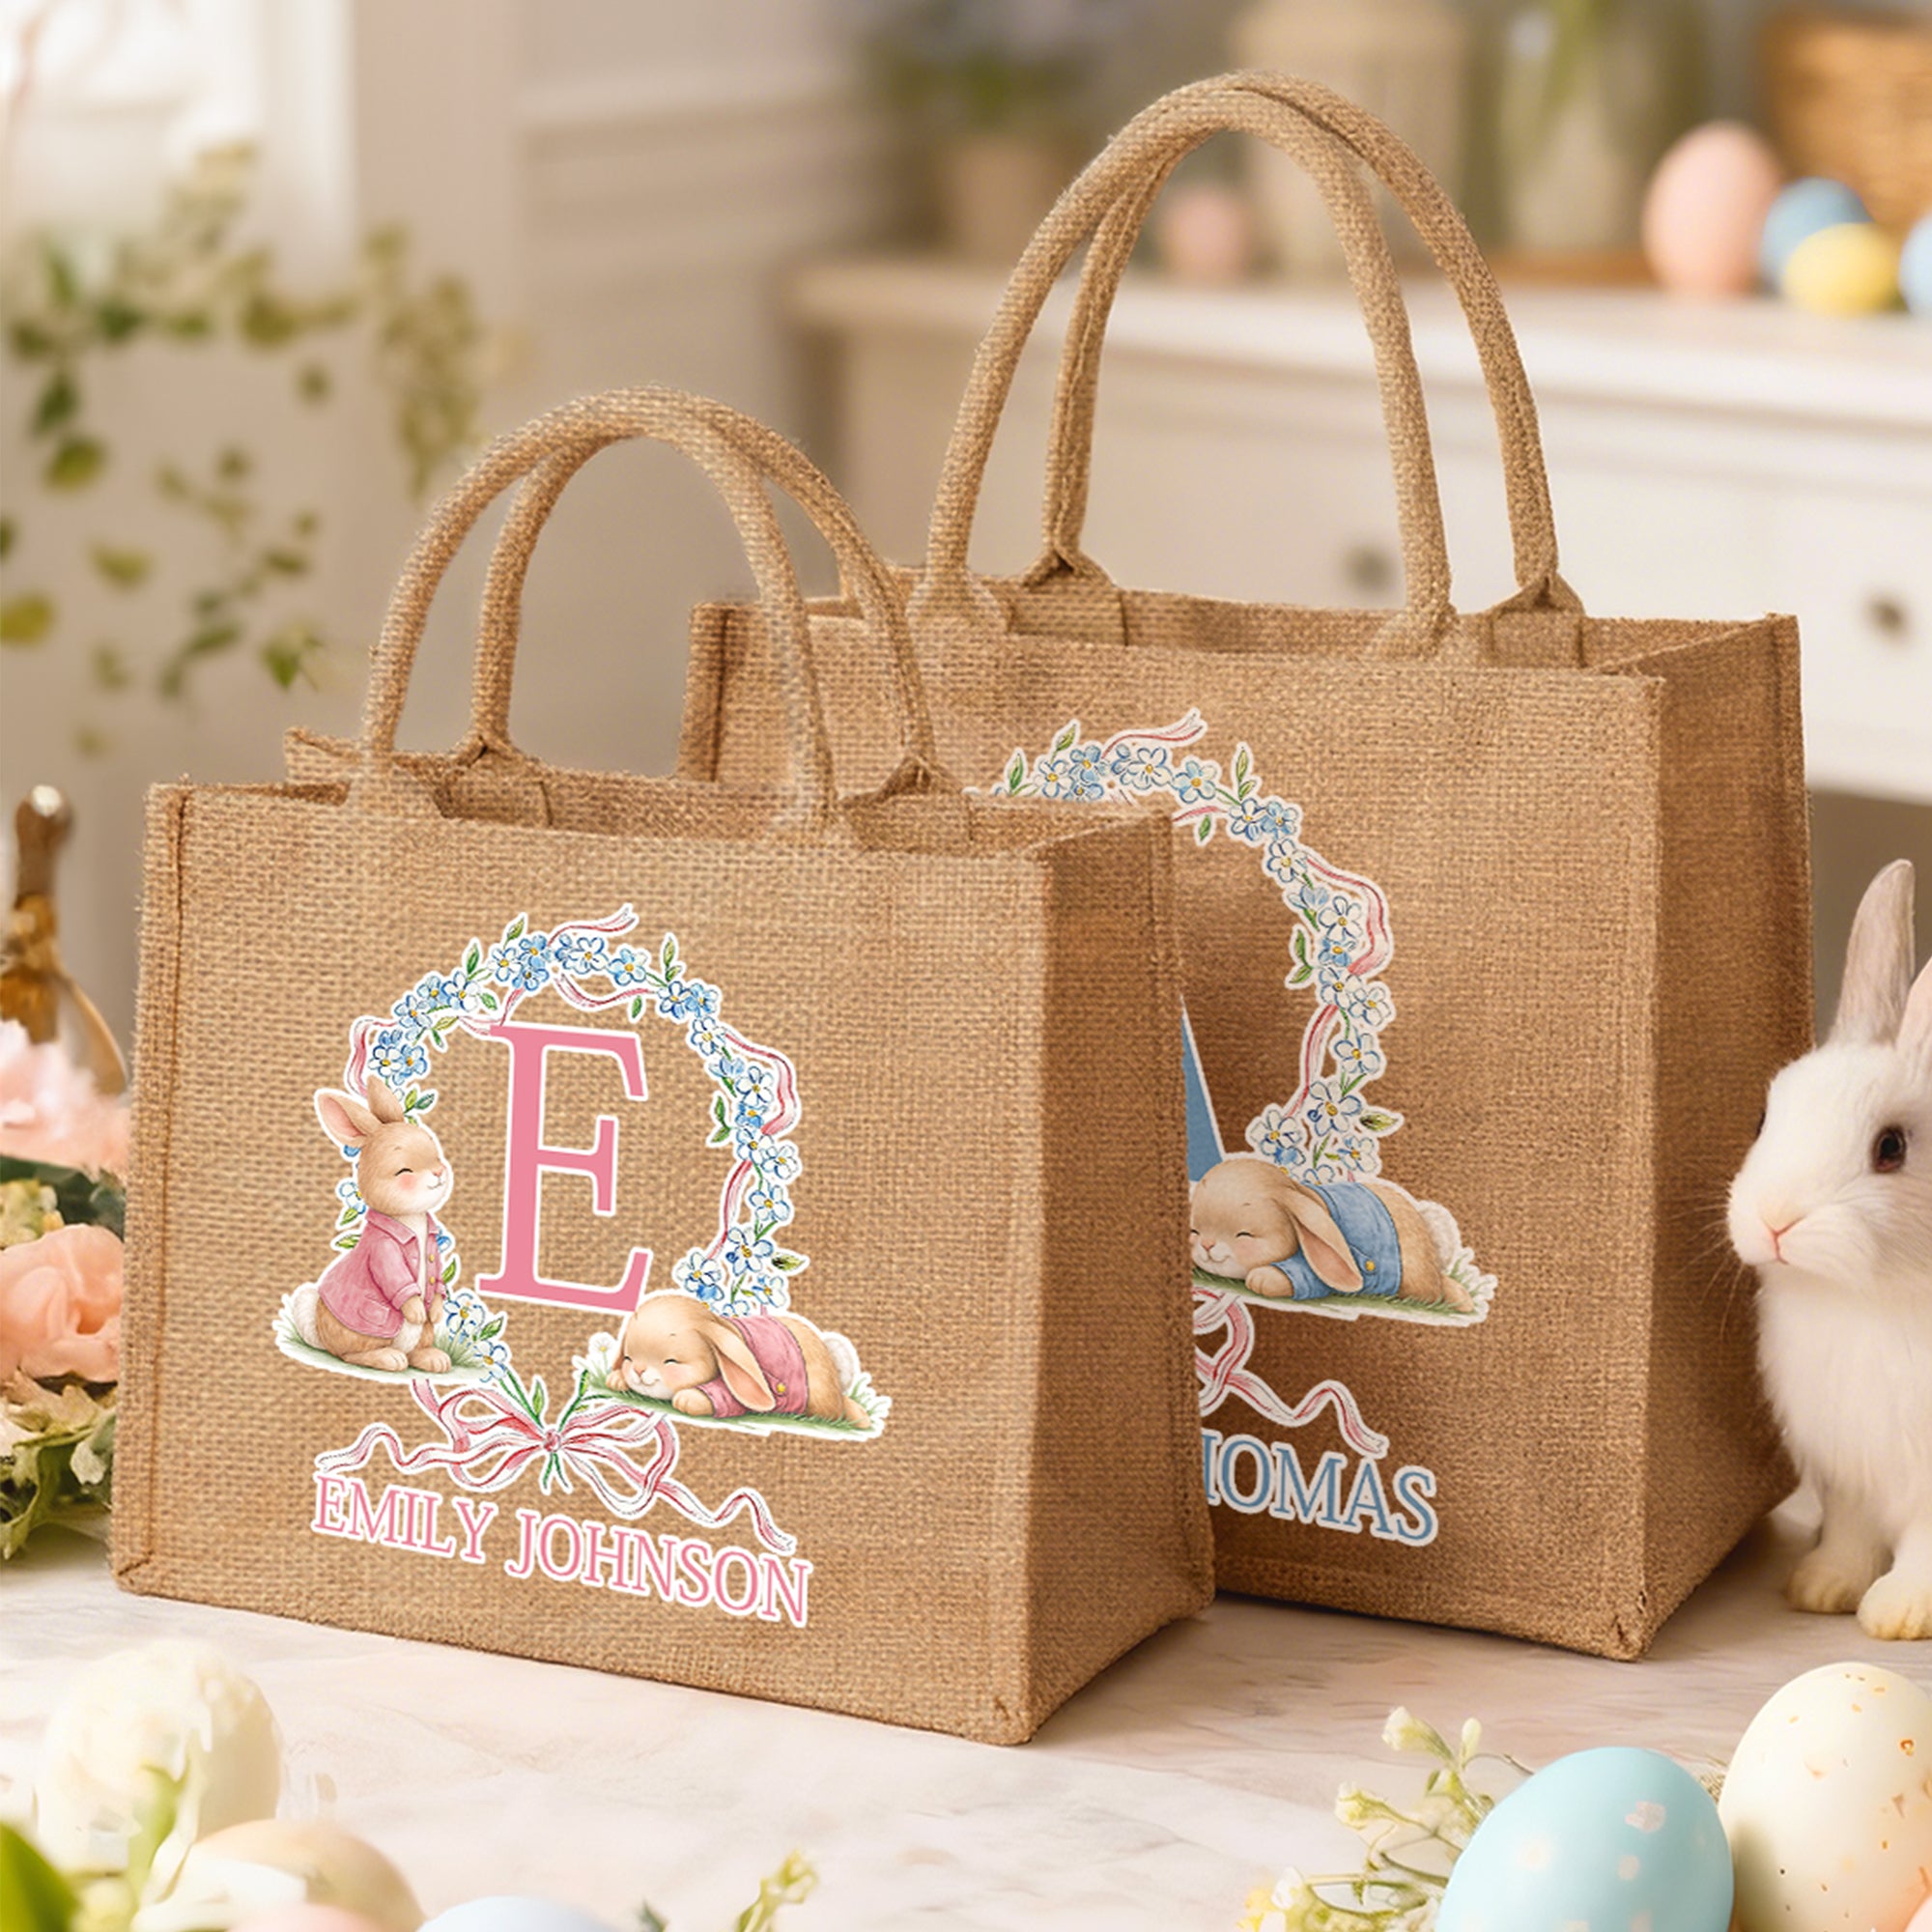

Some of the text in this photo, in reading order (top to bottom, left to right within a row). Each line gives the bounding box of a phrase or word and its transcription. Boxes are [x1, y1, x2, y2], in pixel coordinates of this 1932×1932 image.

[479, 1025, 649, 1312] E
[313, 1475, 810, 1623] EMILY JOHNSON
